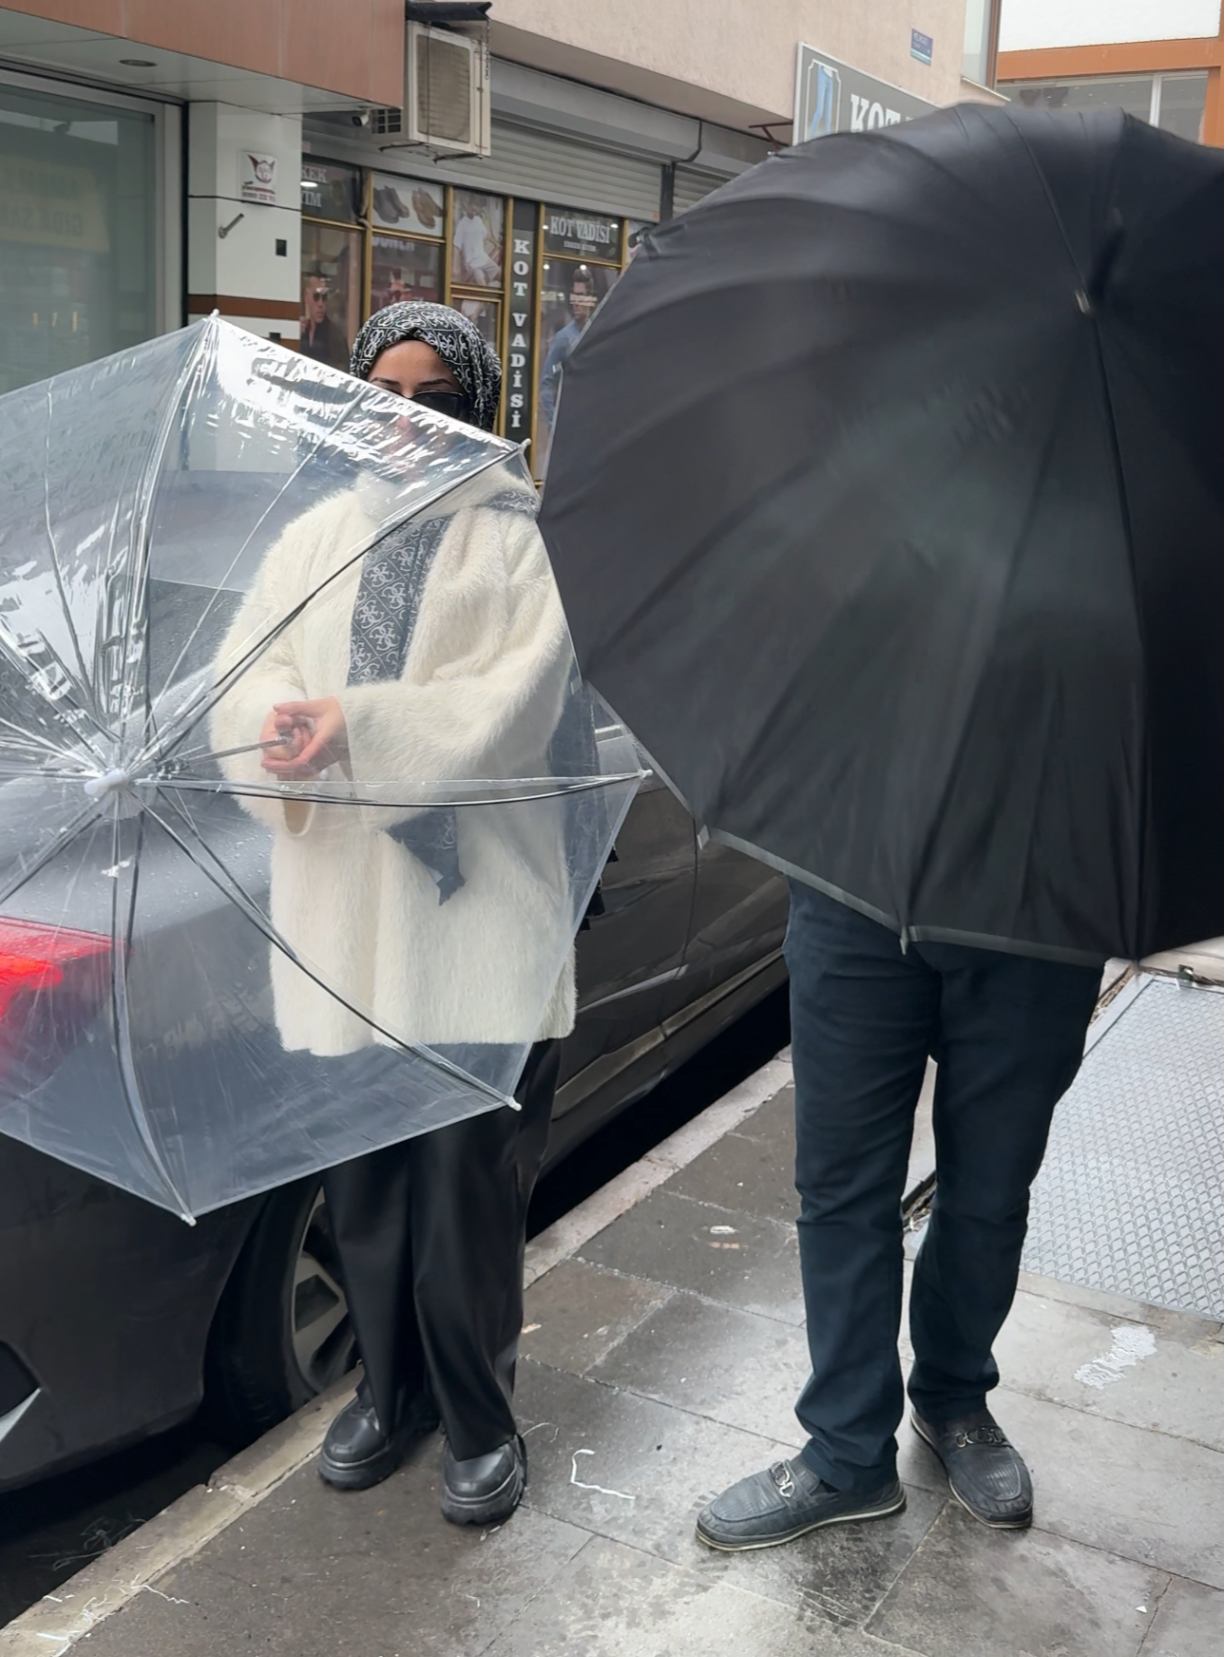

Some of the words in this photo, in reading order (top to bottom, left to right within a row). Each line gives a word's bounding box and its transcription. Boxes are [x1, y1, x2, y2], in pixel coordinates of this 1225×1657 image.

[550, 216, 574, 237] KOT
[513, 239, 530, 297] KOT
[510, 313, 528, 428] VADİSİ
